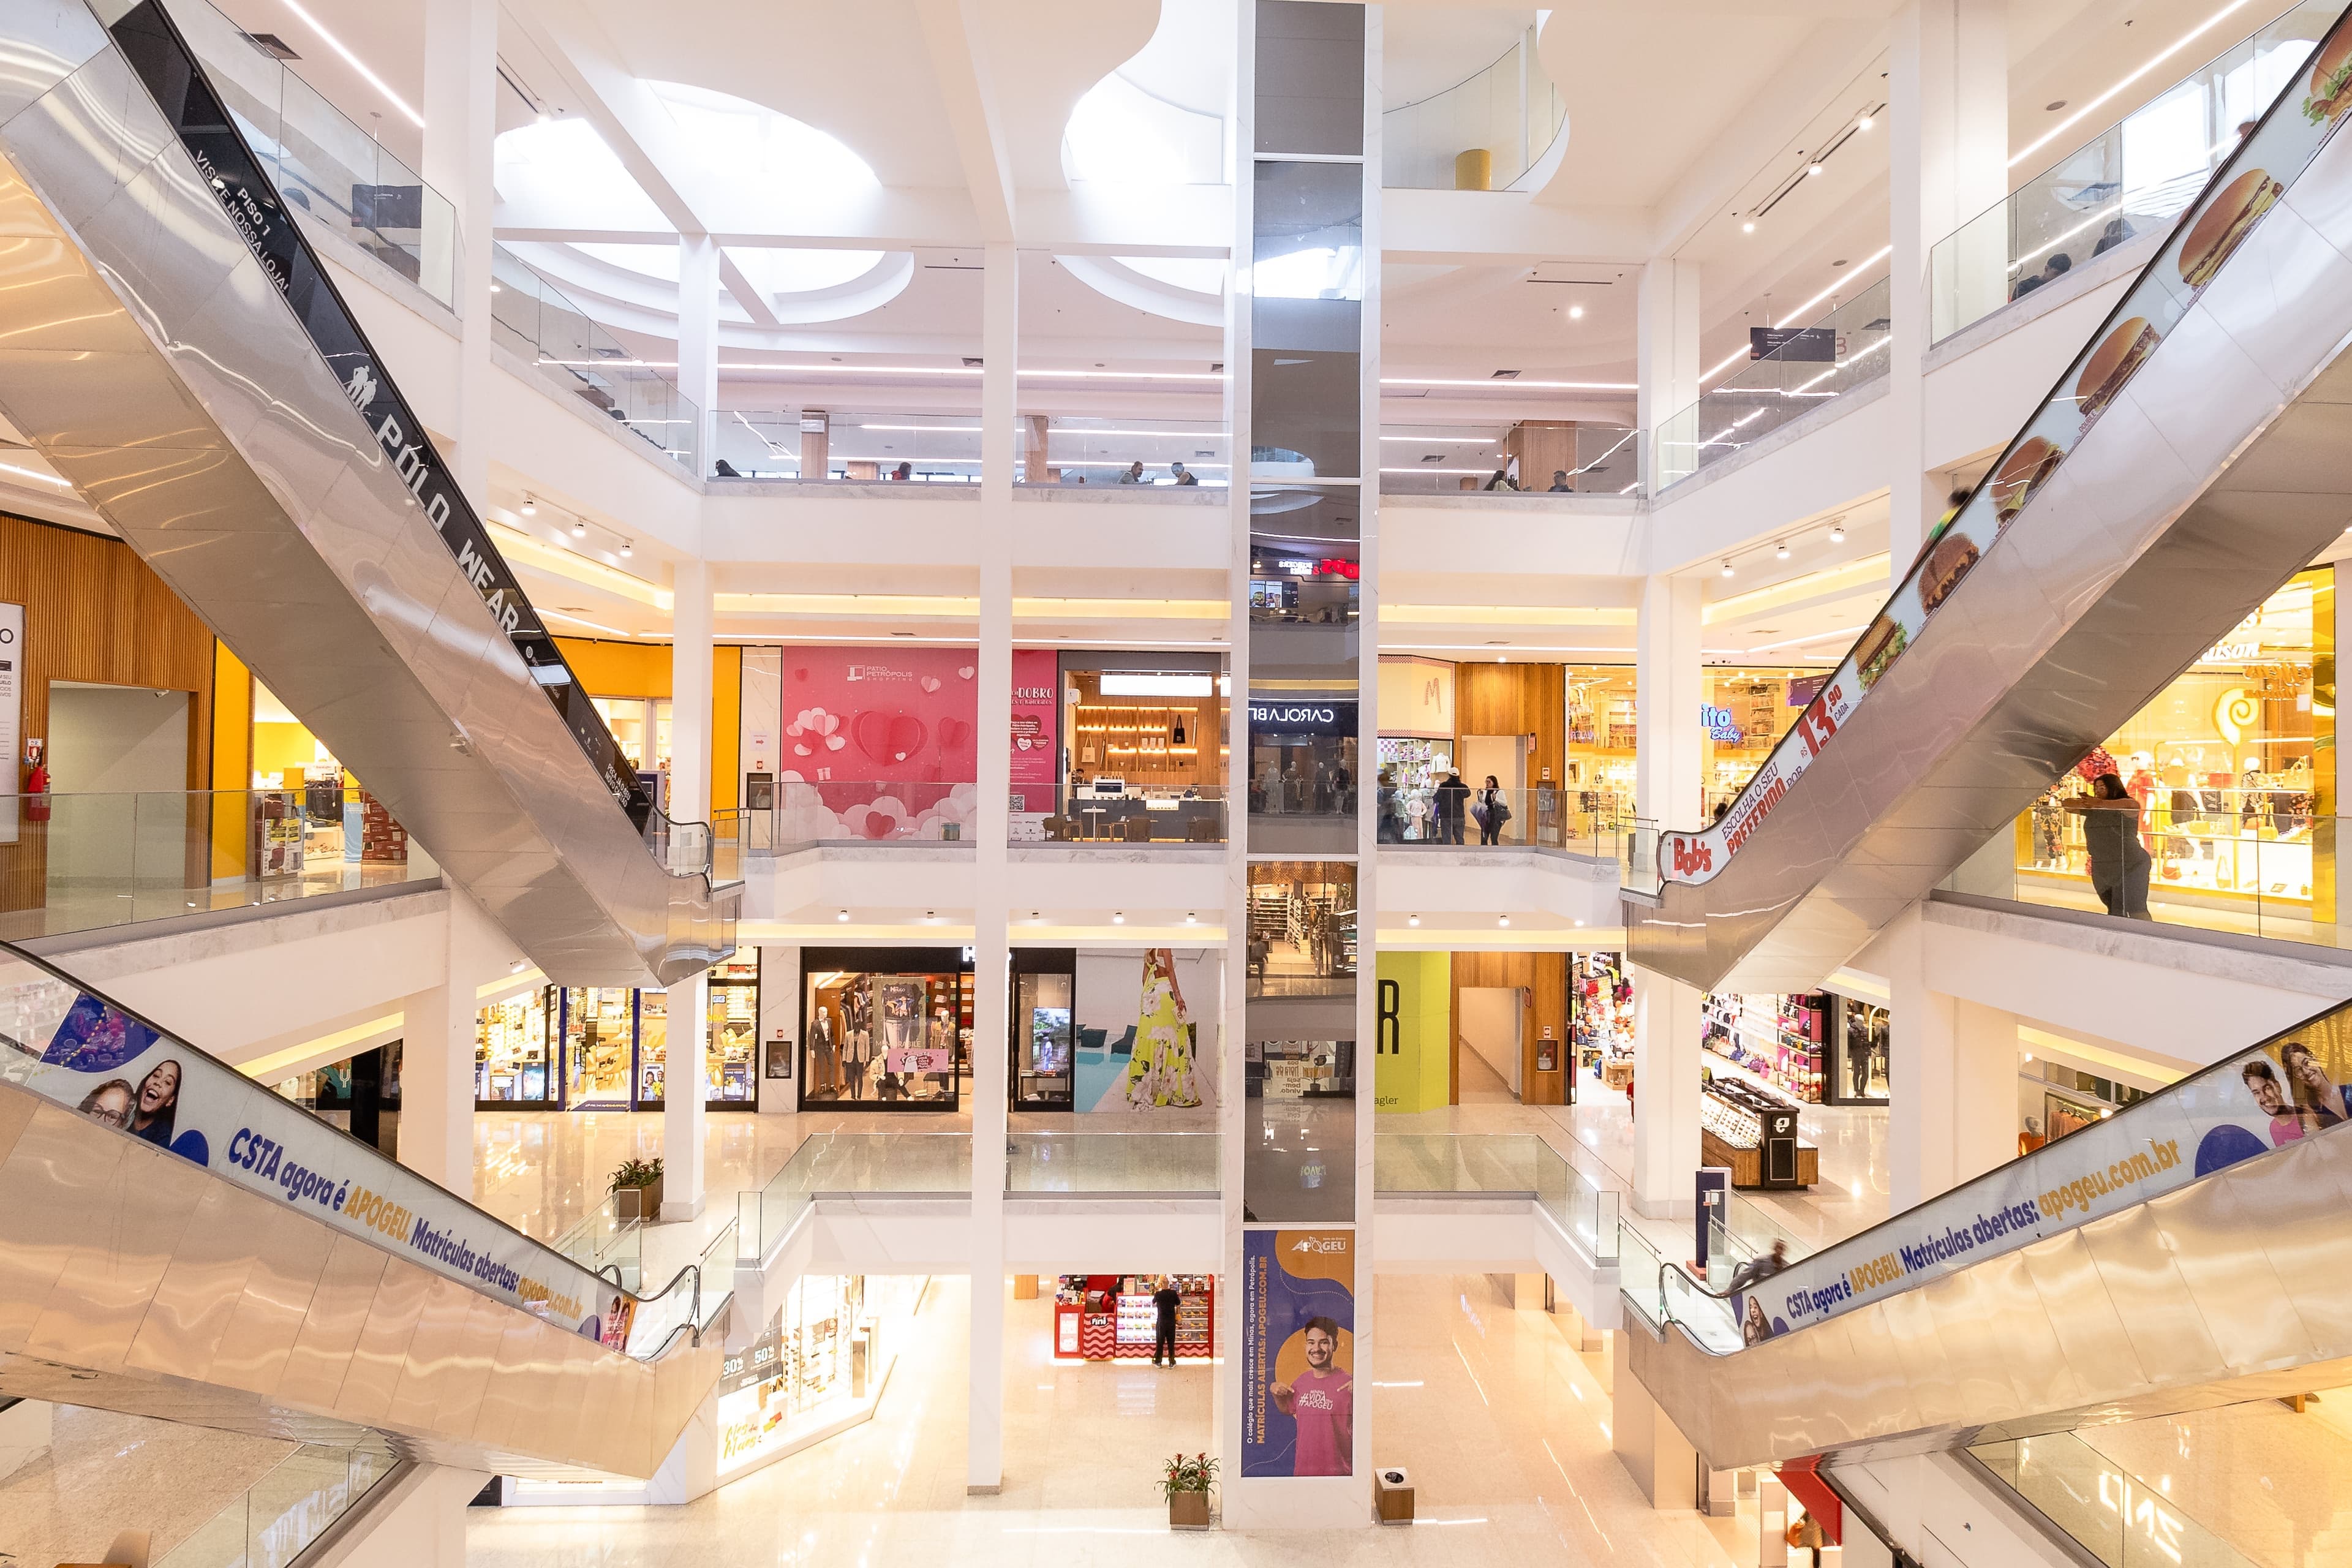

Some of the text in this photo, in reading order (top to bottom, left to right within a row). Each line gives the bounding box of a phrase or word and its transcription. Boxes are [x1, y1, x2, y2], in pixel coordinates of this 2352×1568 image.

[238, 187, 271, 236] PISO 1
[228, 200, 262, 254] NOSSA
[261, 251, 289, 292] LOJA!
[375, 413, 519, 636] POLO WEAR
[1018, 687, 1054, 698] DOBRO
[1702, 704, 1731, 727] ito
[1834, 702, 1849, 722] CADA
[1711, 726, 1741, 744] Baby
[1722, 761, 1779, 840] ESCOLHA O SEU
[1727, 766, 1803, 857] PREFERIDO POR
[1674, 837, 1712, 876] Bob's
[1377, 979, 1400, 1055] R
[1374, 1096, 1399, 1107] agler
[228, 1128, 584, 1322] CSTA agora é APOGEU. Matrículas abertas: apogeu.com.br
[1785, 1137, 2182, 1319] CSTA agora é APOGEU. Matrículas abertas: apogeu.com.br
[1291, 1236, 1346, 1254] APOGEU
[1250, 1291, 1255, 1302] em
[1248, 1347, 1254, 1357] em
[1256, 1256, 1267, 1444] MATRÍCULAS ABERTAS: APOGEU.COM.BR
[1304, 1400, 1333, 1410] APOGEU
[1310, 1393, 1325, 1402] VIDA
